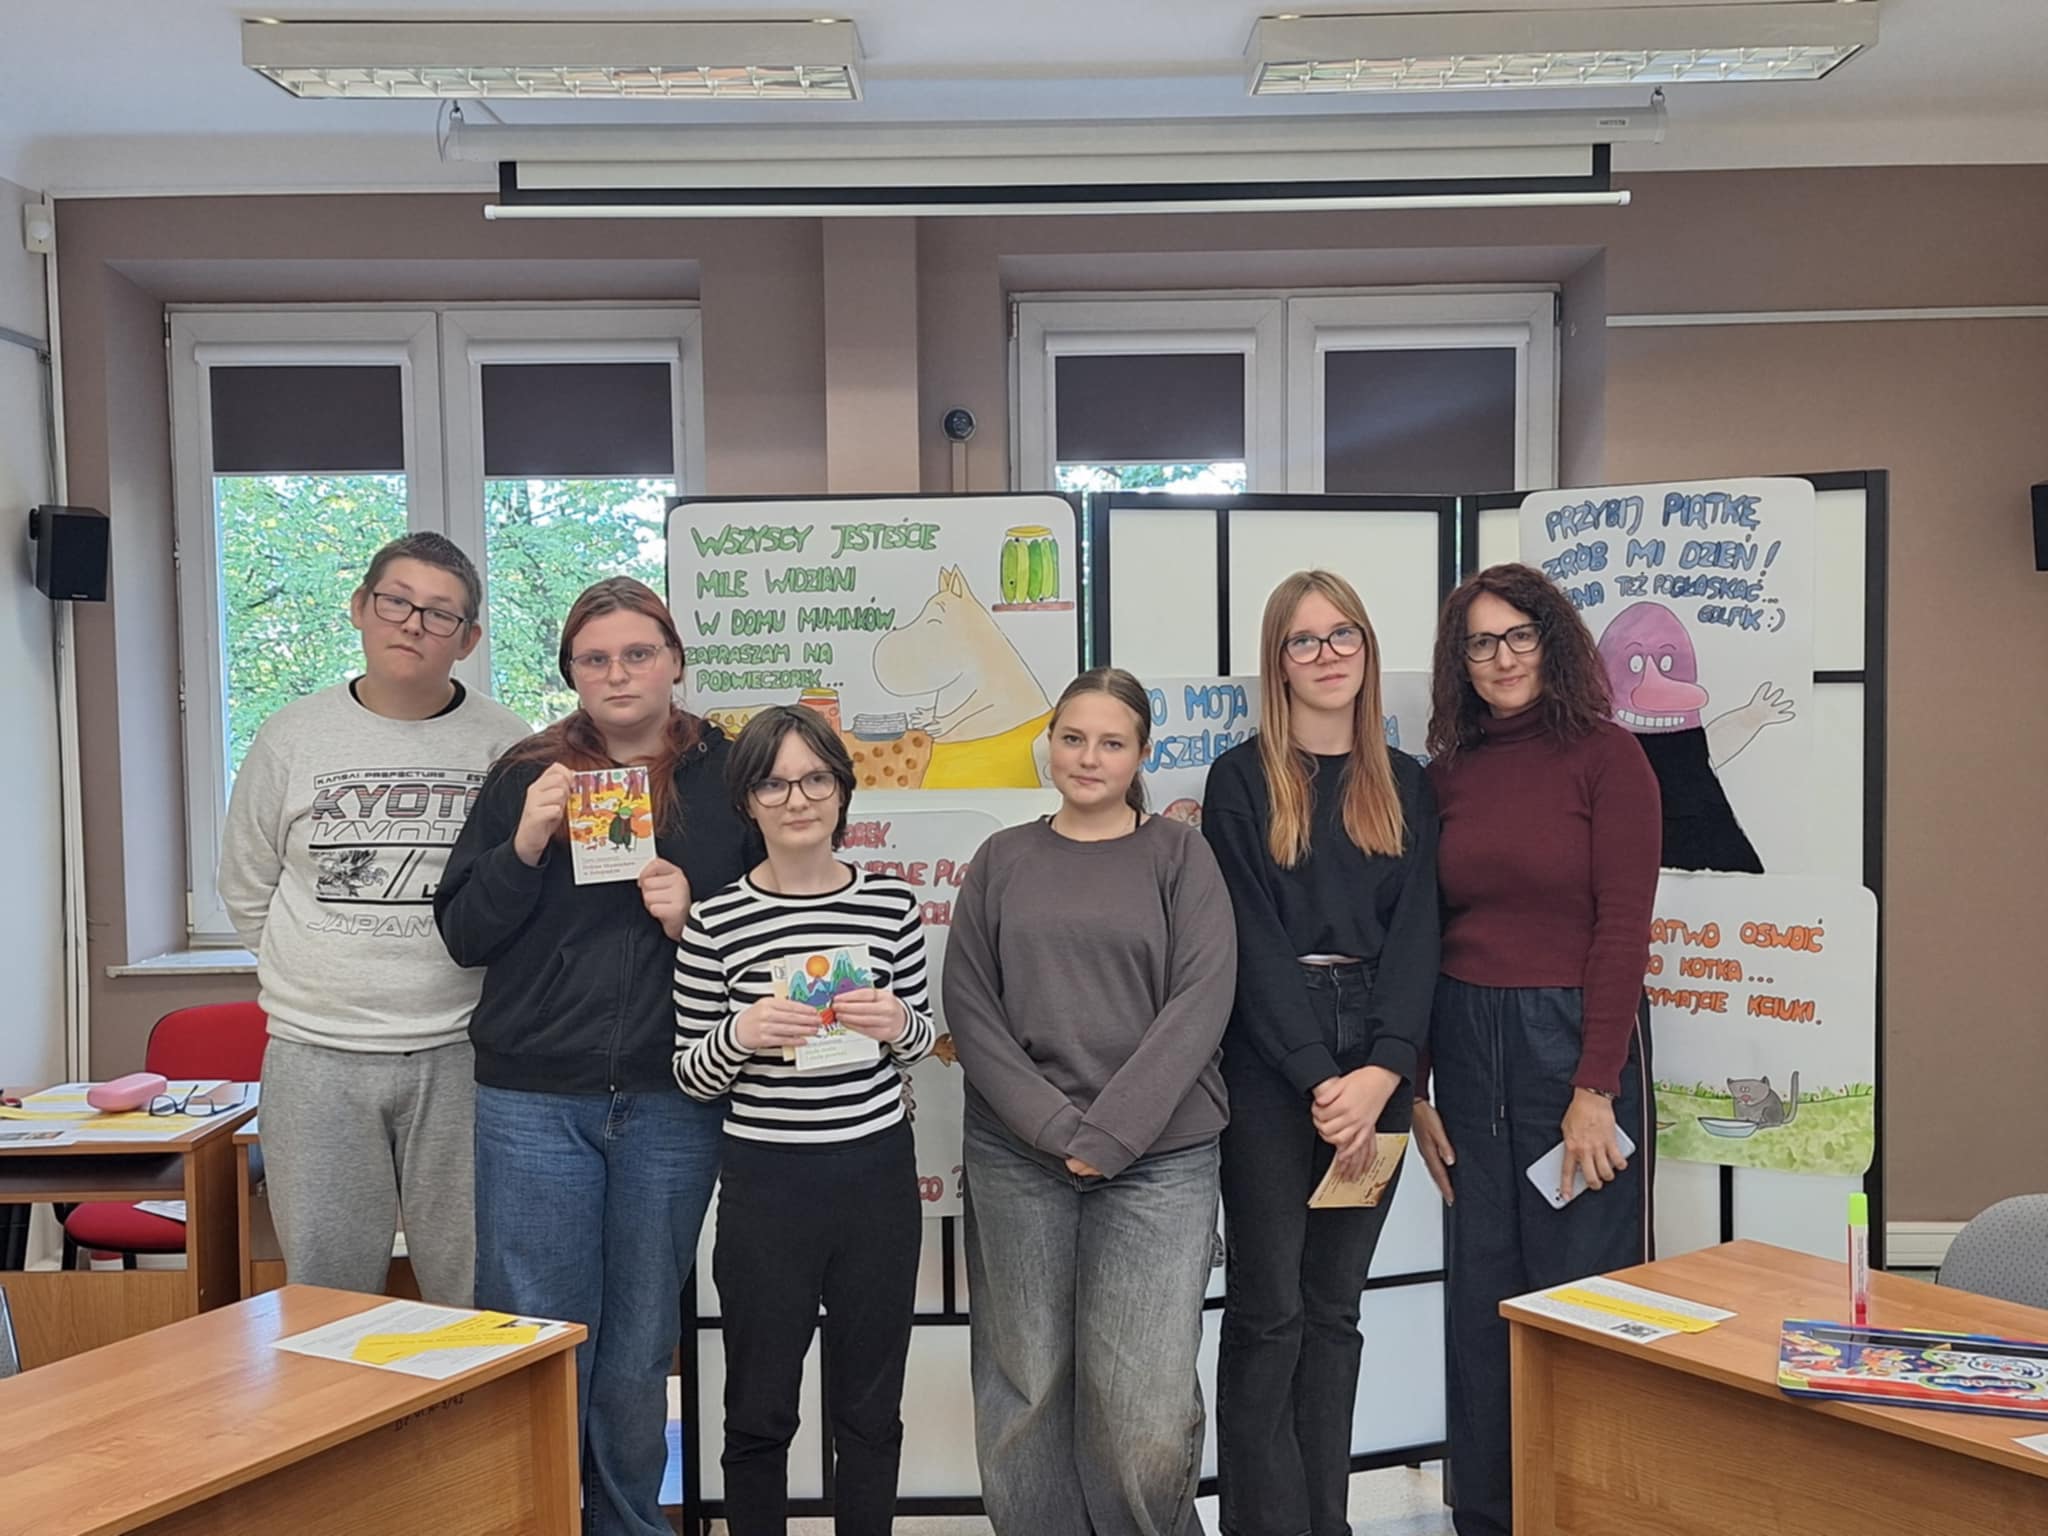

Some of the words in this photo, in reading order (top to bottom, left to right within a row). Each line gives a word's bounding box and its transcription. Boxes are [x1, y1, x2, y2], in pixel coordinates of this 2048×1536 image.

[1545, 495, 1644, 542] PRZYBIJ
[1662, 491, 1762, 531] PIĄTKĘ
[691, 524, 814, 558] WSZYSCY
[831, 517, 940, 559] JESTEŚCIE
[1542, 541, 1608, 581] ZRÓB
[1626, 538, 1665, 568] MI
[697, 569, 749, 599] MILE
[765, 566, 856, 594] WIDZIANI
[1614, 572, 1648, 596] TEŻ
[694, 610, 720, 636] W
[731, 609, 786, 637] DOMU
[685, 643, 790, 666] ZAPRASZAM
[803, 642, 833, 665] NA
[1184, 684, 1248, 730] MOJA
[307, 912, 434, 937] JAPAN
[1649, 917, 1720, 949] ATWO
[1739, 918, 1824, 952] OSWOIĆ
